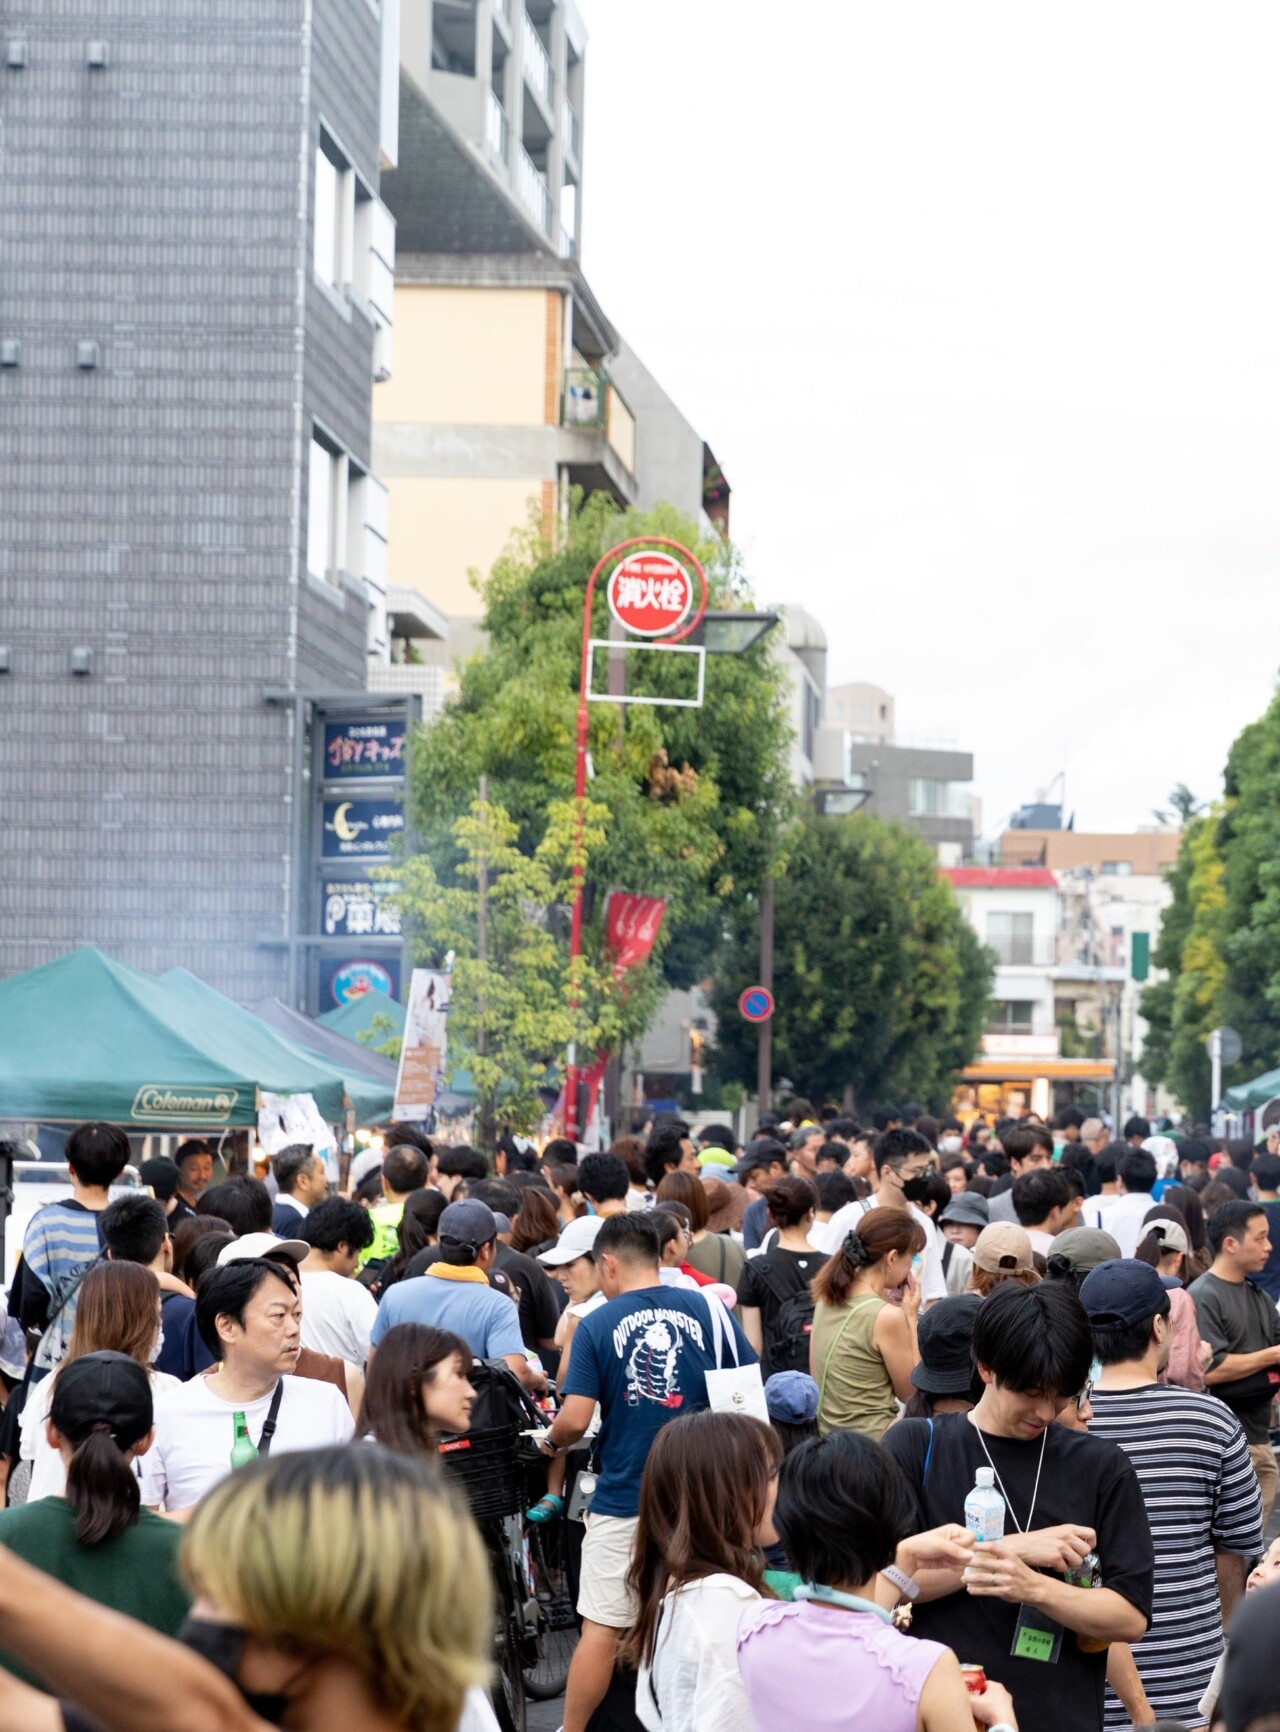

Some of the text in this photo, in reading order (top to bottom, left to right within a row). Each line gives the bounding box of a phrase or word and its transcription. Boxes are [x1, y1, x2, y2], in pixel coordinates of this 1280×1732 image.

[617, 575, 685, 611] 消火栓
[142, 1089, 213, 1111] Coleman
[613, 1308, 705, 1359] OUTDOOR MONSTER
